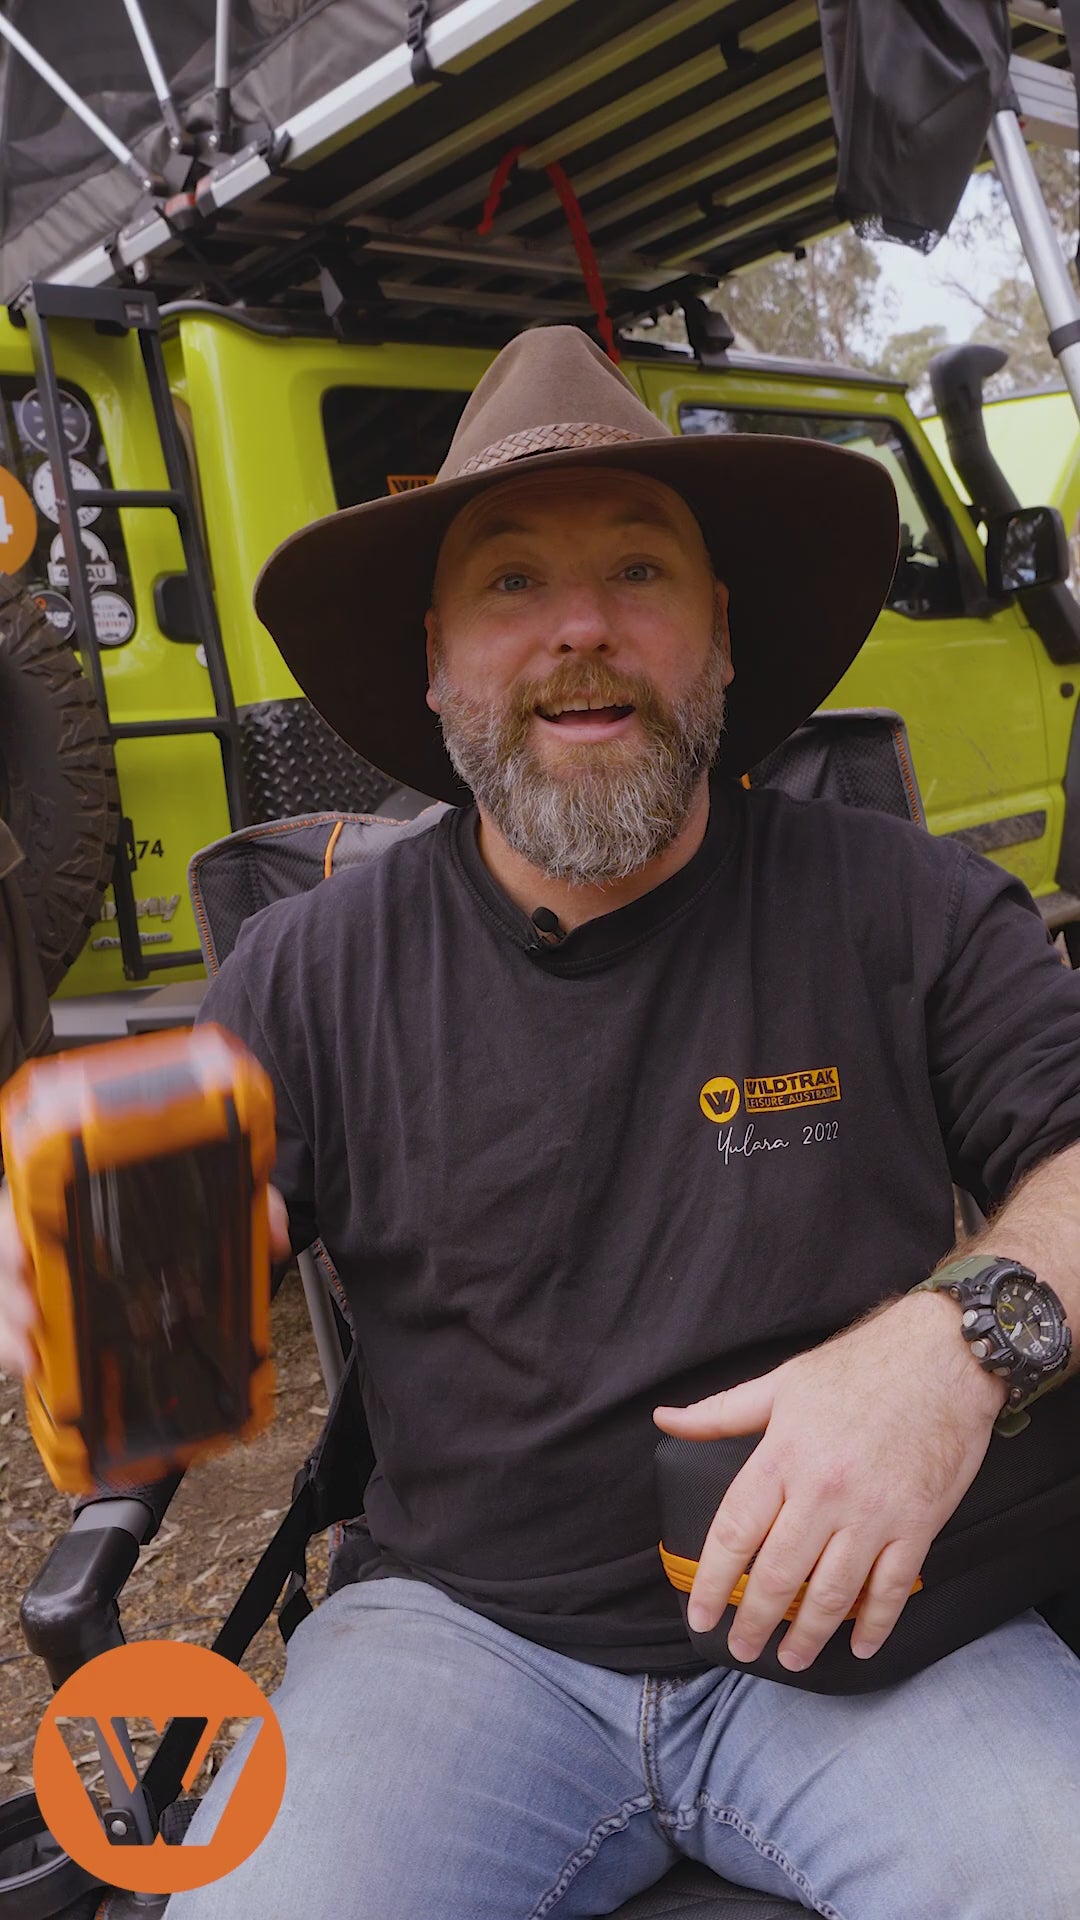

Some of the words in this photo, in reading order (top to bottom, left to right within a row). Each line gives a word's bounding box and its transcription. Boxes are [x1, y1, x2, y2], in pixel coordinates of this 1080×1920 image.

[746, 1070, 836, 1095] WILDTRAK
[747, 1097, 785, 1108] LEISURE
[788, 1087, 837, 1104] AUSTRALIA
[717, 1123, 790, 1165] Yulara
[802, 1121, 839, 1144] 2022
